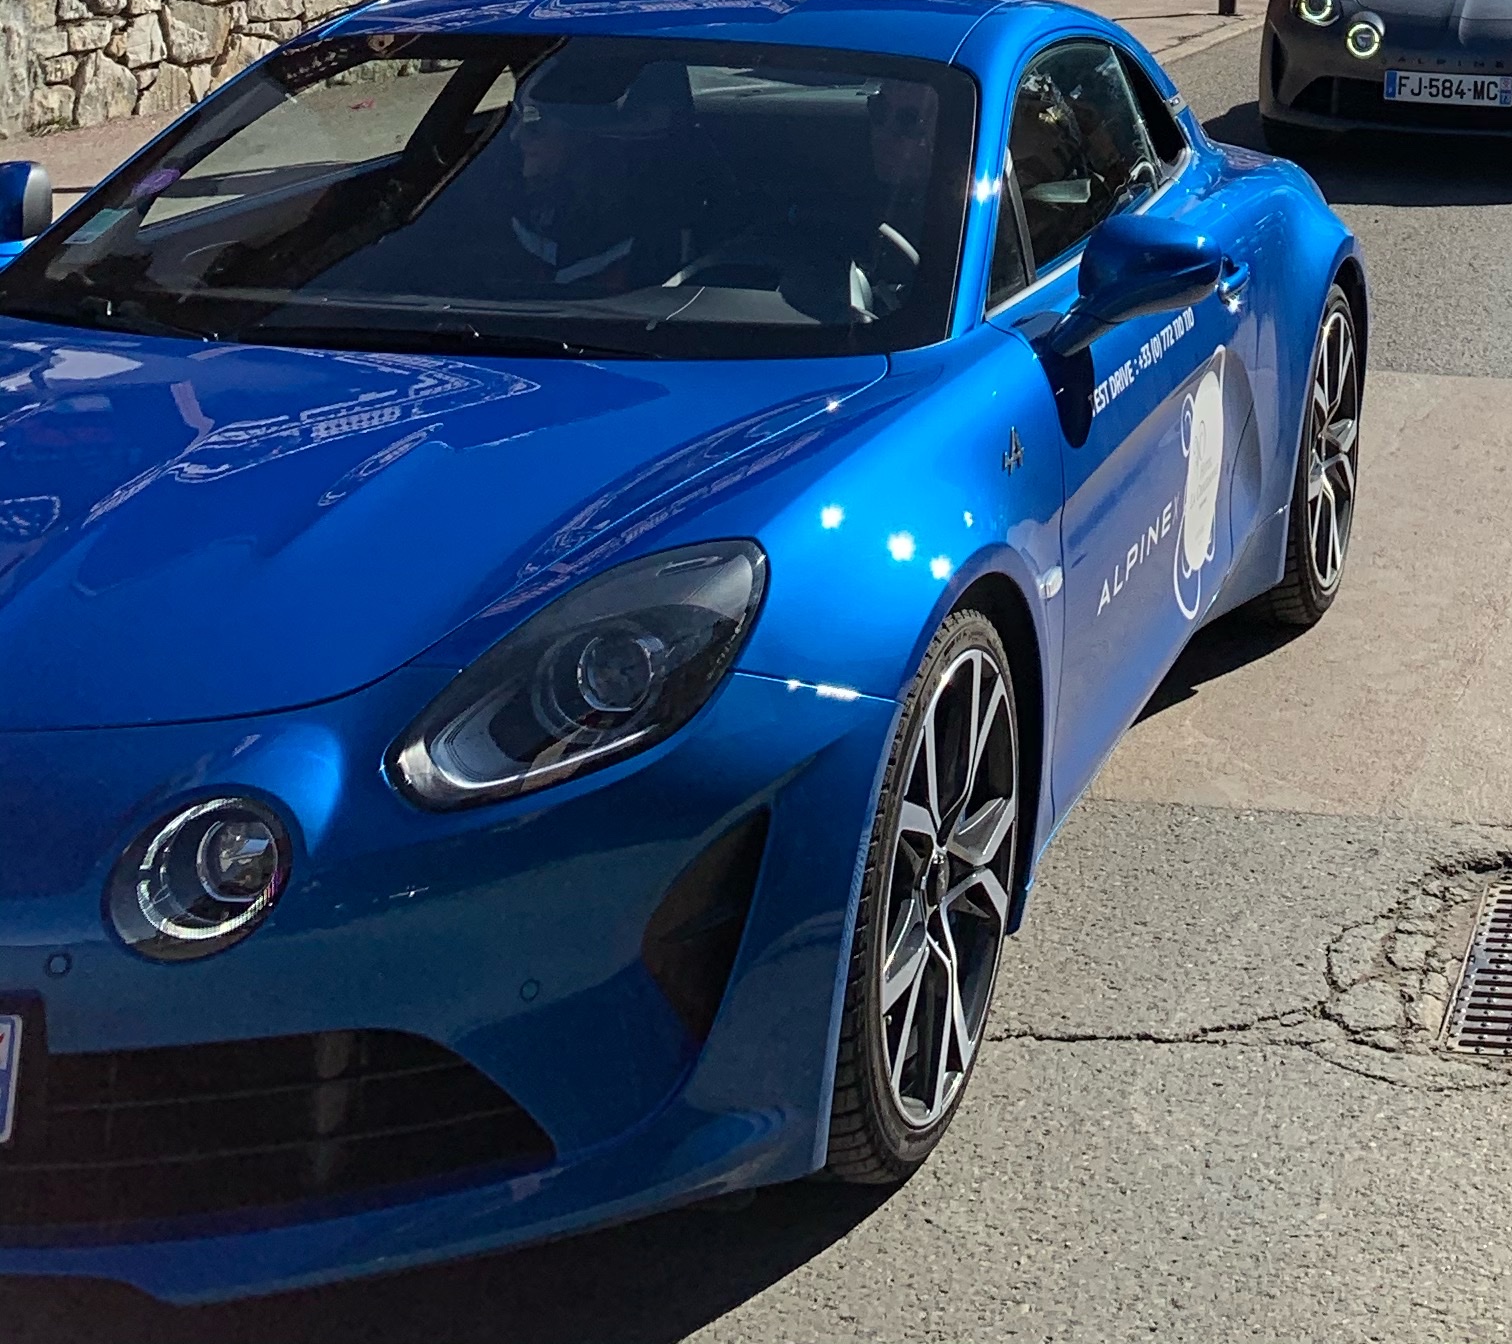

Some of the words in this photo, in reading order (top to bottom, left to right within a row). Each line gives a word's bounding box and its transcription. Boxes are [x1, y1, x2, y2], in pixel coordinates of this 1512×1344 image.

[1397, 75, 1499, 101] FJ-584-MC
[1108, 359, 1135, 400] DRIVE
[1096, 500, 1172, 617] ALPINE
